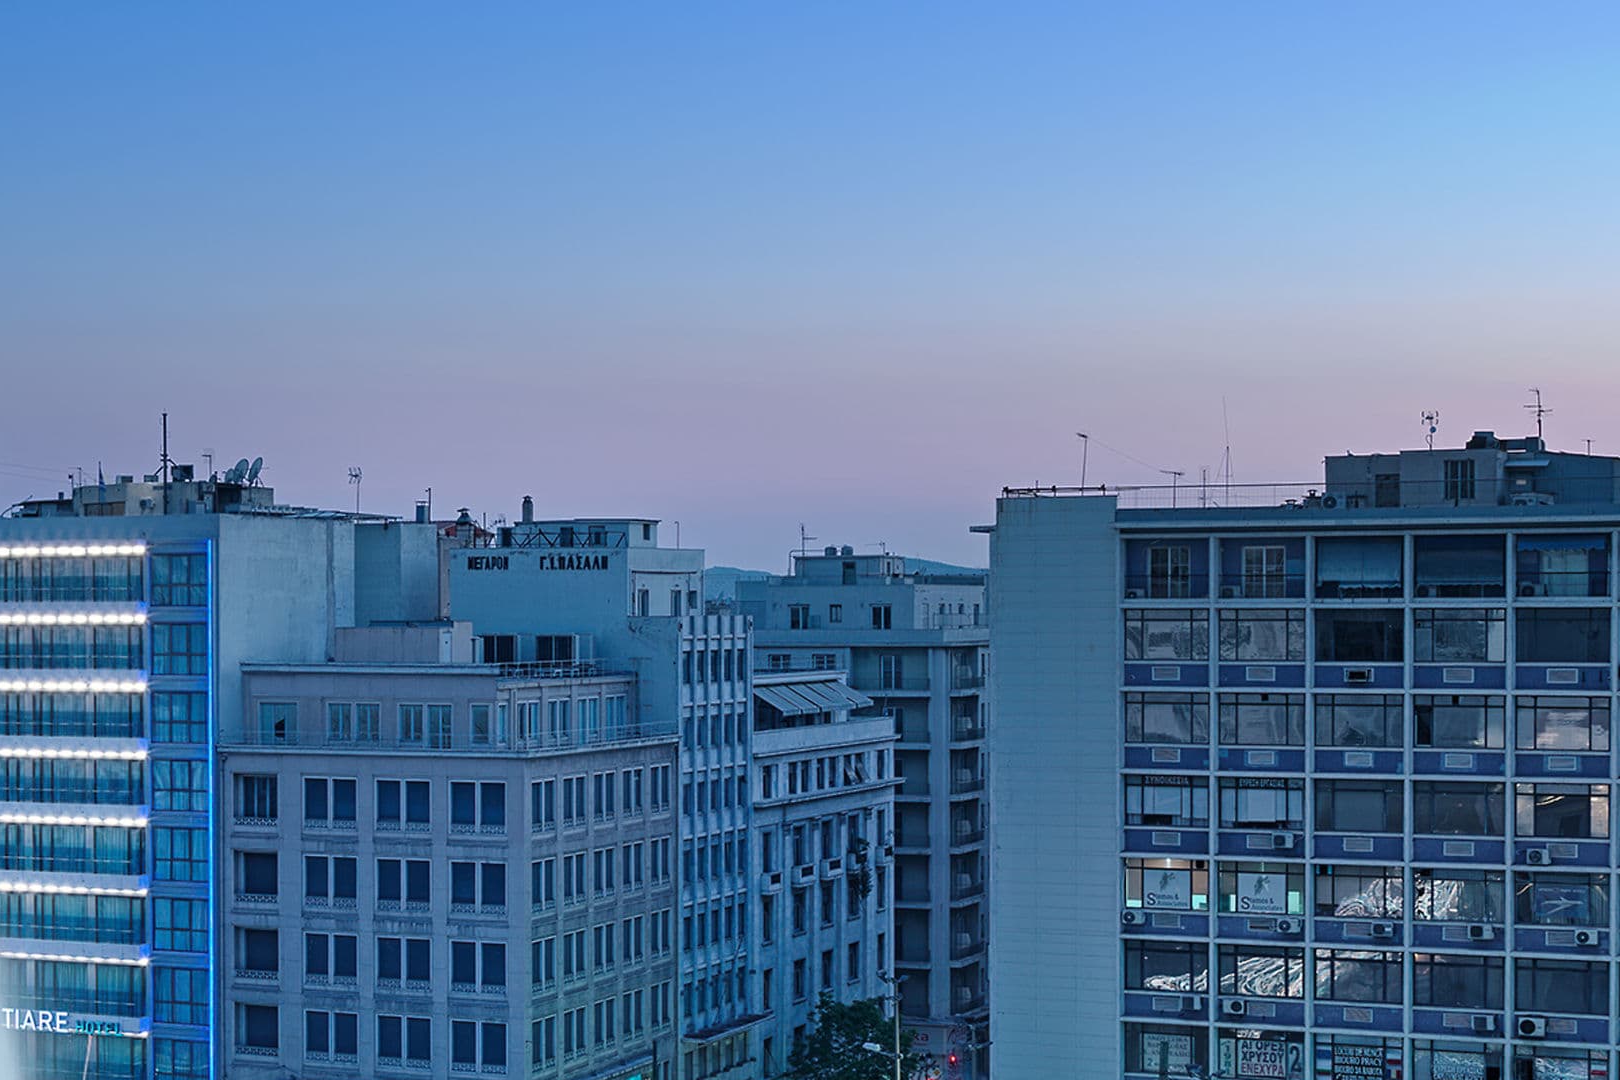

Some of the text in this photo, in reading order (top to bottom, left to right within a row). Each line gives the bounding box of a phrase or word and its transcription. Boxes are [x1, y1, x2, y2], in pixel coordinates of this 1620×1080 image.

[467, 555, 510, 571] ΜΕΓΑΡΟΝ
[1, 1007, 69, 1033] TIARE
[75, 1019, 124, 1037] HOTEL
[1241, 1050, 1285, 1064] ΧΡΥΣΟΥ
[1241, 1062, 1285, 1076] ΕΝΕΧΥΡΑ
